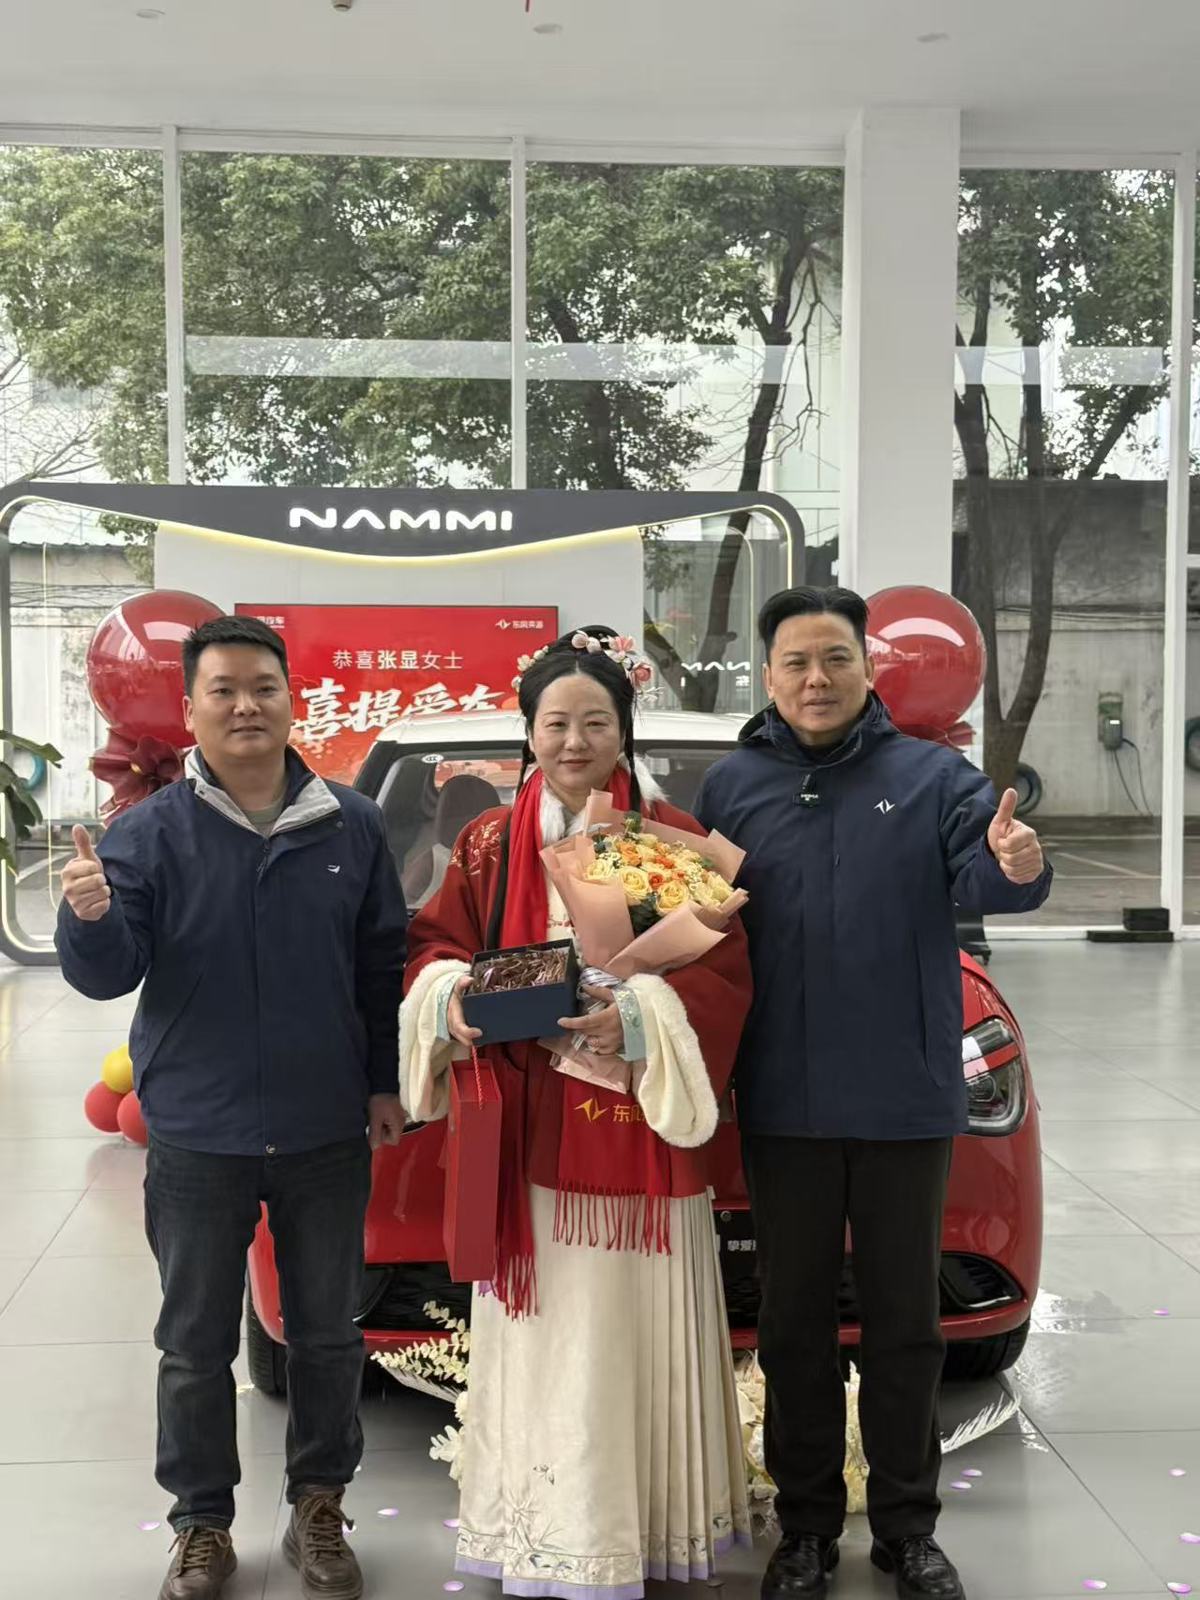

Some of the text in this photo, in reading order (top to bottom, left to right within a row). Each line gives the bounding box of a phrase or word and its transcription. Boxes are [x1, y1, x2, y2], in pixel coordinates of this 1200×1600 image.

[289, 507, 513, 531] NAMMI
[332, 649, 463, 670] 恭喜张显女士
